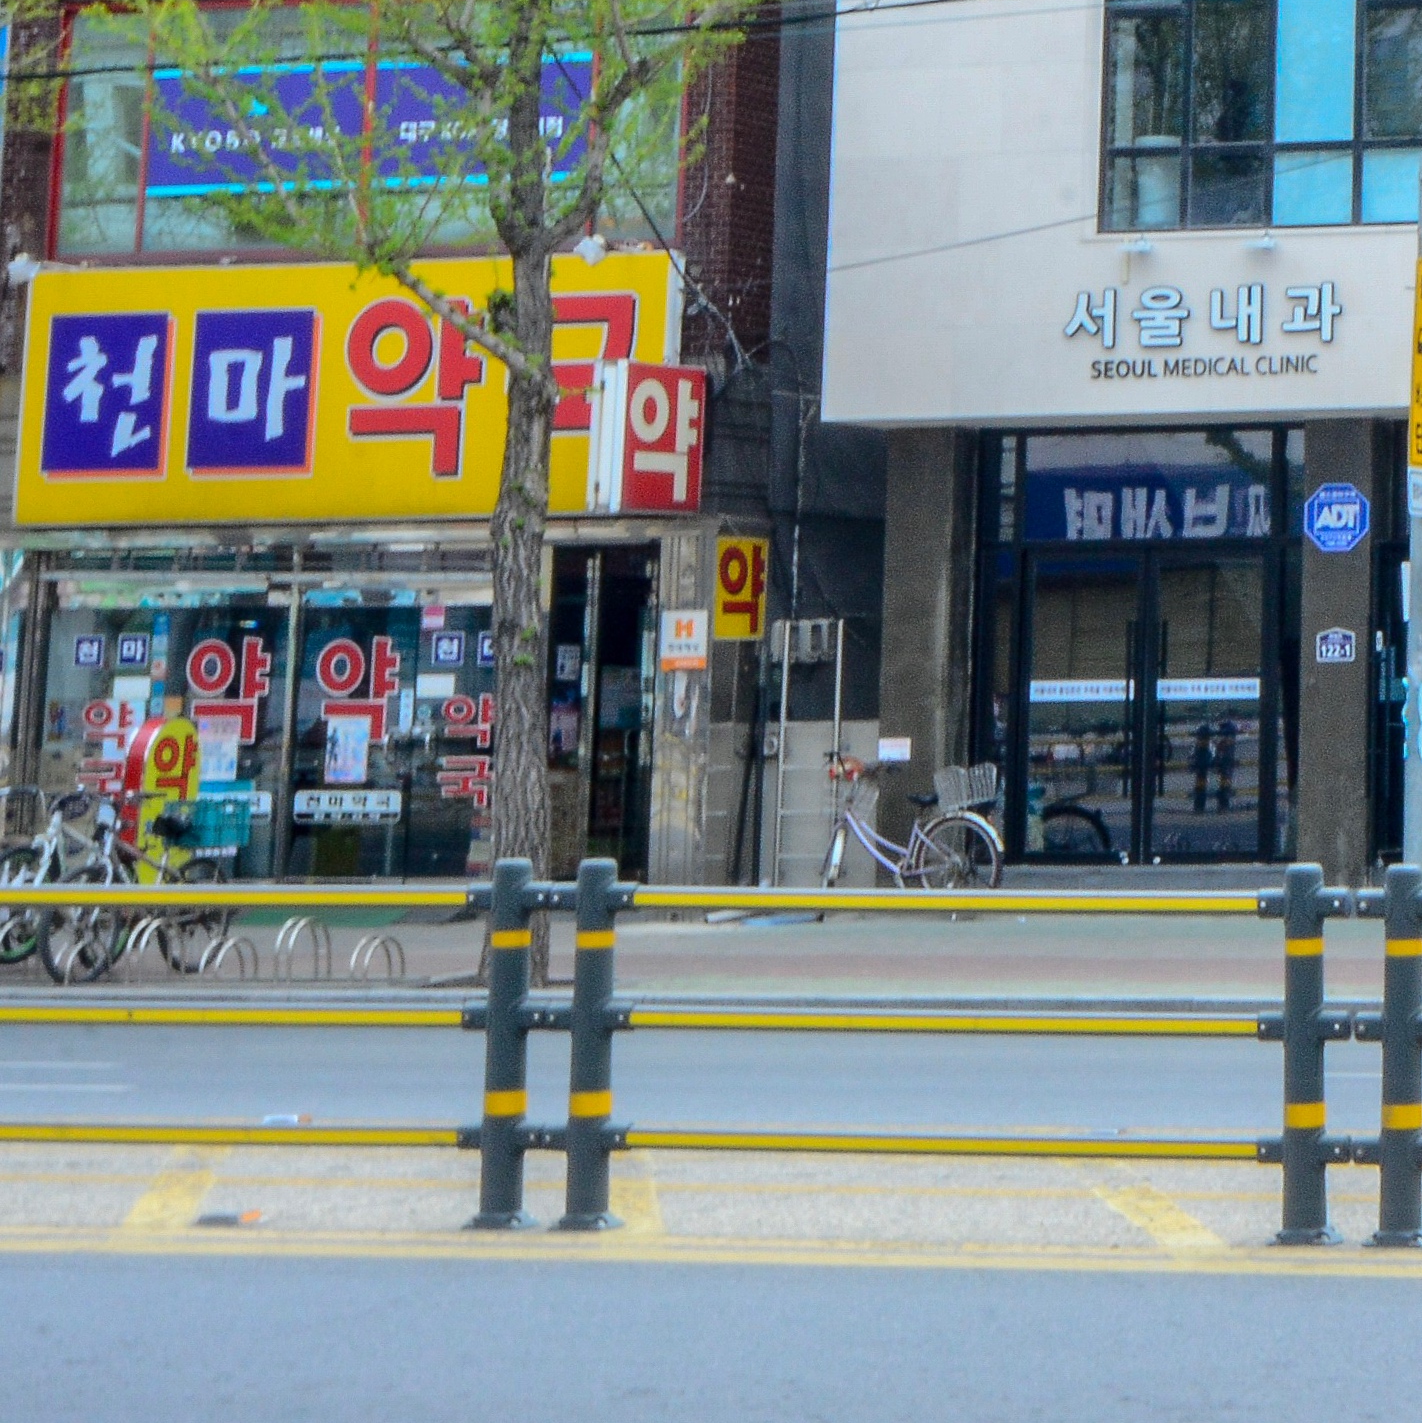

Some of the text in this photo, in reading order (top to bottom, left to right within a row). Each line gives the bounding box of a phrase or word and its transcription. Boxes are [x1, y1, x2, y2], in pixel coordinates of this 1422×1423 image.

[1064, 281, 1341, 349] 서울내과
[1091, 354, 1318, 380] SEOUL MEDICAL CLINIC
[631, 377, 699, 503] 약
[1315, 503, 1360, 529] ADT
[719, 545, 766, 634] 약
[187, 636, 272, 745] 약
[316, 635, 400, 745] 약
[154, 734, 198, 802] 약
